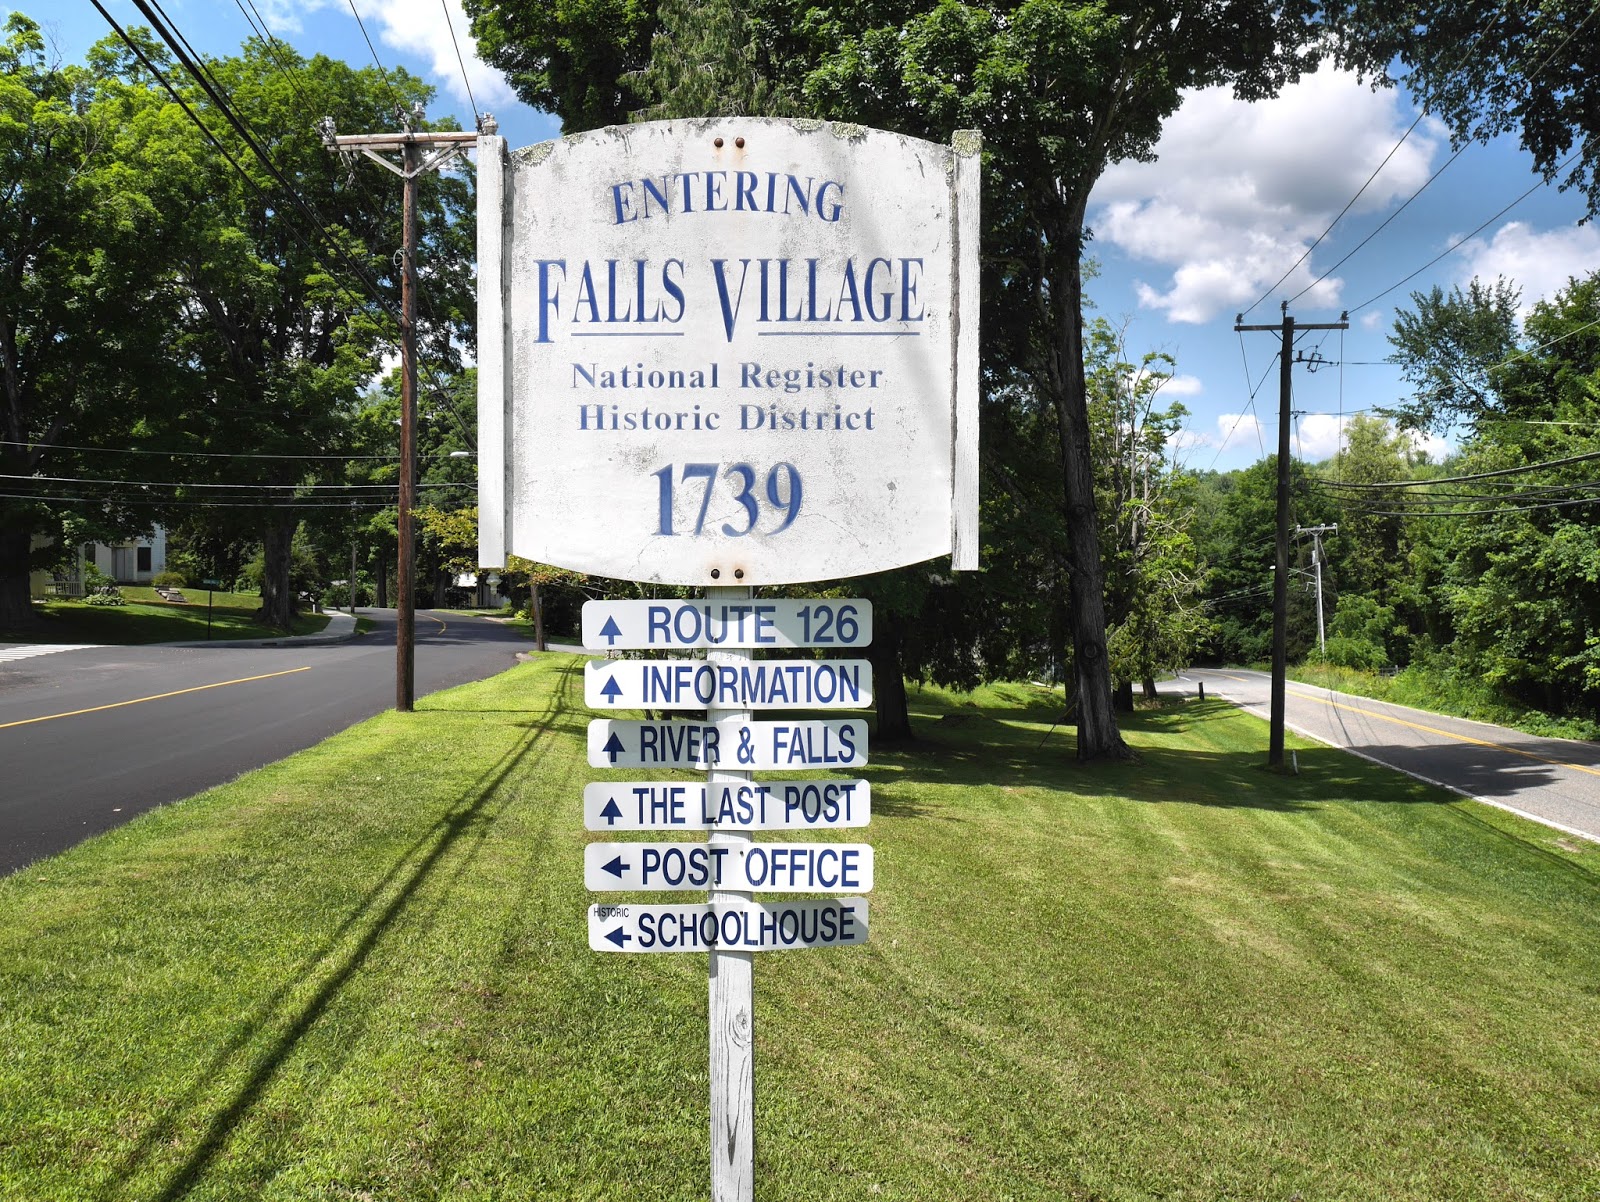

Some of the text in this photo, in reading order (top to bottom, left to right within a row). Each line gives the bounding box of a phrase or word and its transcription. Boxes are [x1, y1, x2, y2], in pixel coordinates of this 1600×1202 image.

[612, 171, 844, 225] ENTERING
[533, 257, 924, 343] FALLS VILLAGE
[570, 361, 883, 393] National Register
[577, 404, 876, 431] Historic District
[650, 462, 803, 538] 1739
[648, 605, 859, 644] ROUTE 126
[642, 665, 860, 704] INFORMATION
[640, 724, 856, 764] RIVER & FALLS
[632, 784, 856, 825] THE LAST POST
[642, 848, 860, 888] POST OFFICE
[593, 907, 630, 918] HISTORIC
[638, 907, 855, 948] SCHOOLHOUSE
